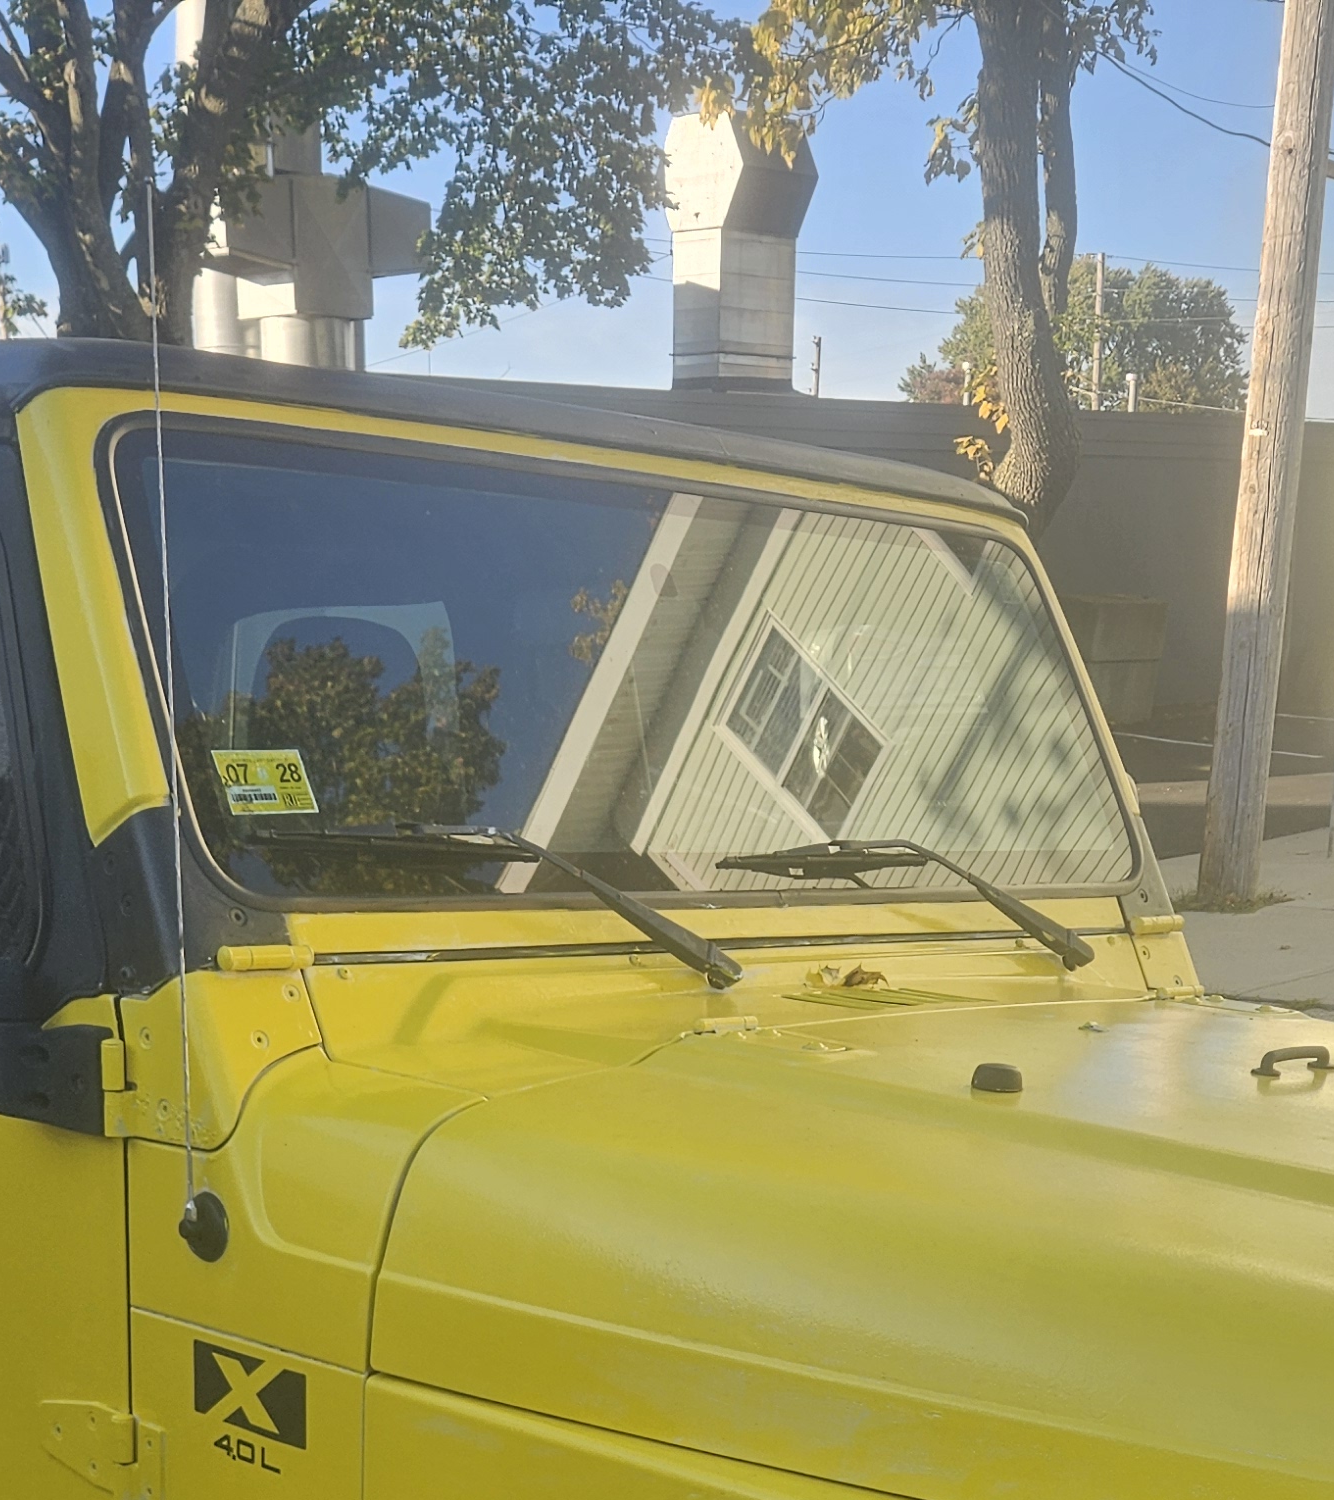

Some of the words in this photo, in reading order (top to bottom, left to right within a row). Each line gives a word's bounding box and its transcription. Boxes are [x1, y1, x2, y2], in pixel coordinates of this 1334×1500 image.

[225, 763, 249, 784] 07
[275, 762, 302, 783] 28
[197, 1342, 295, 1442] X
